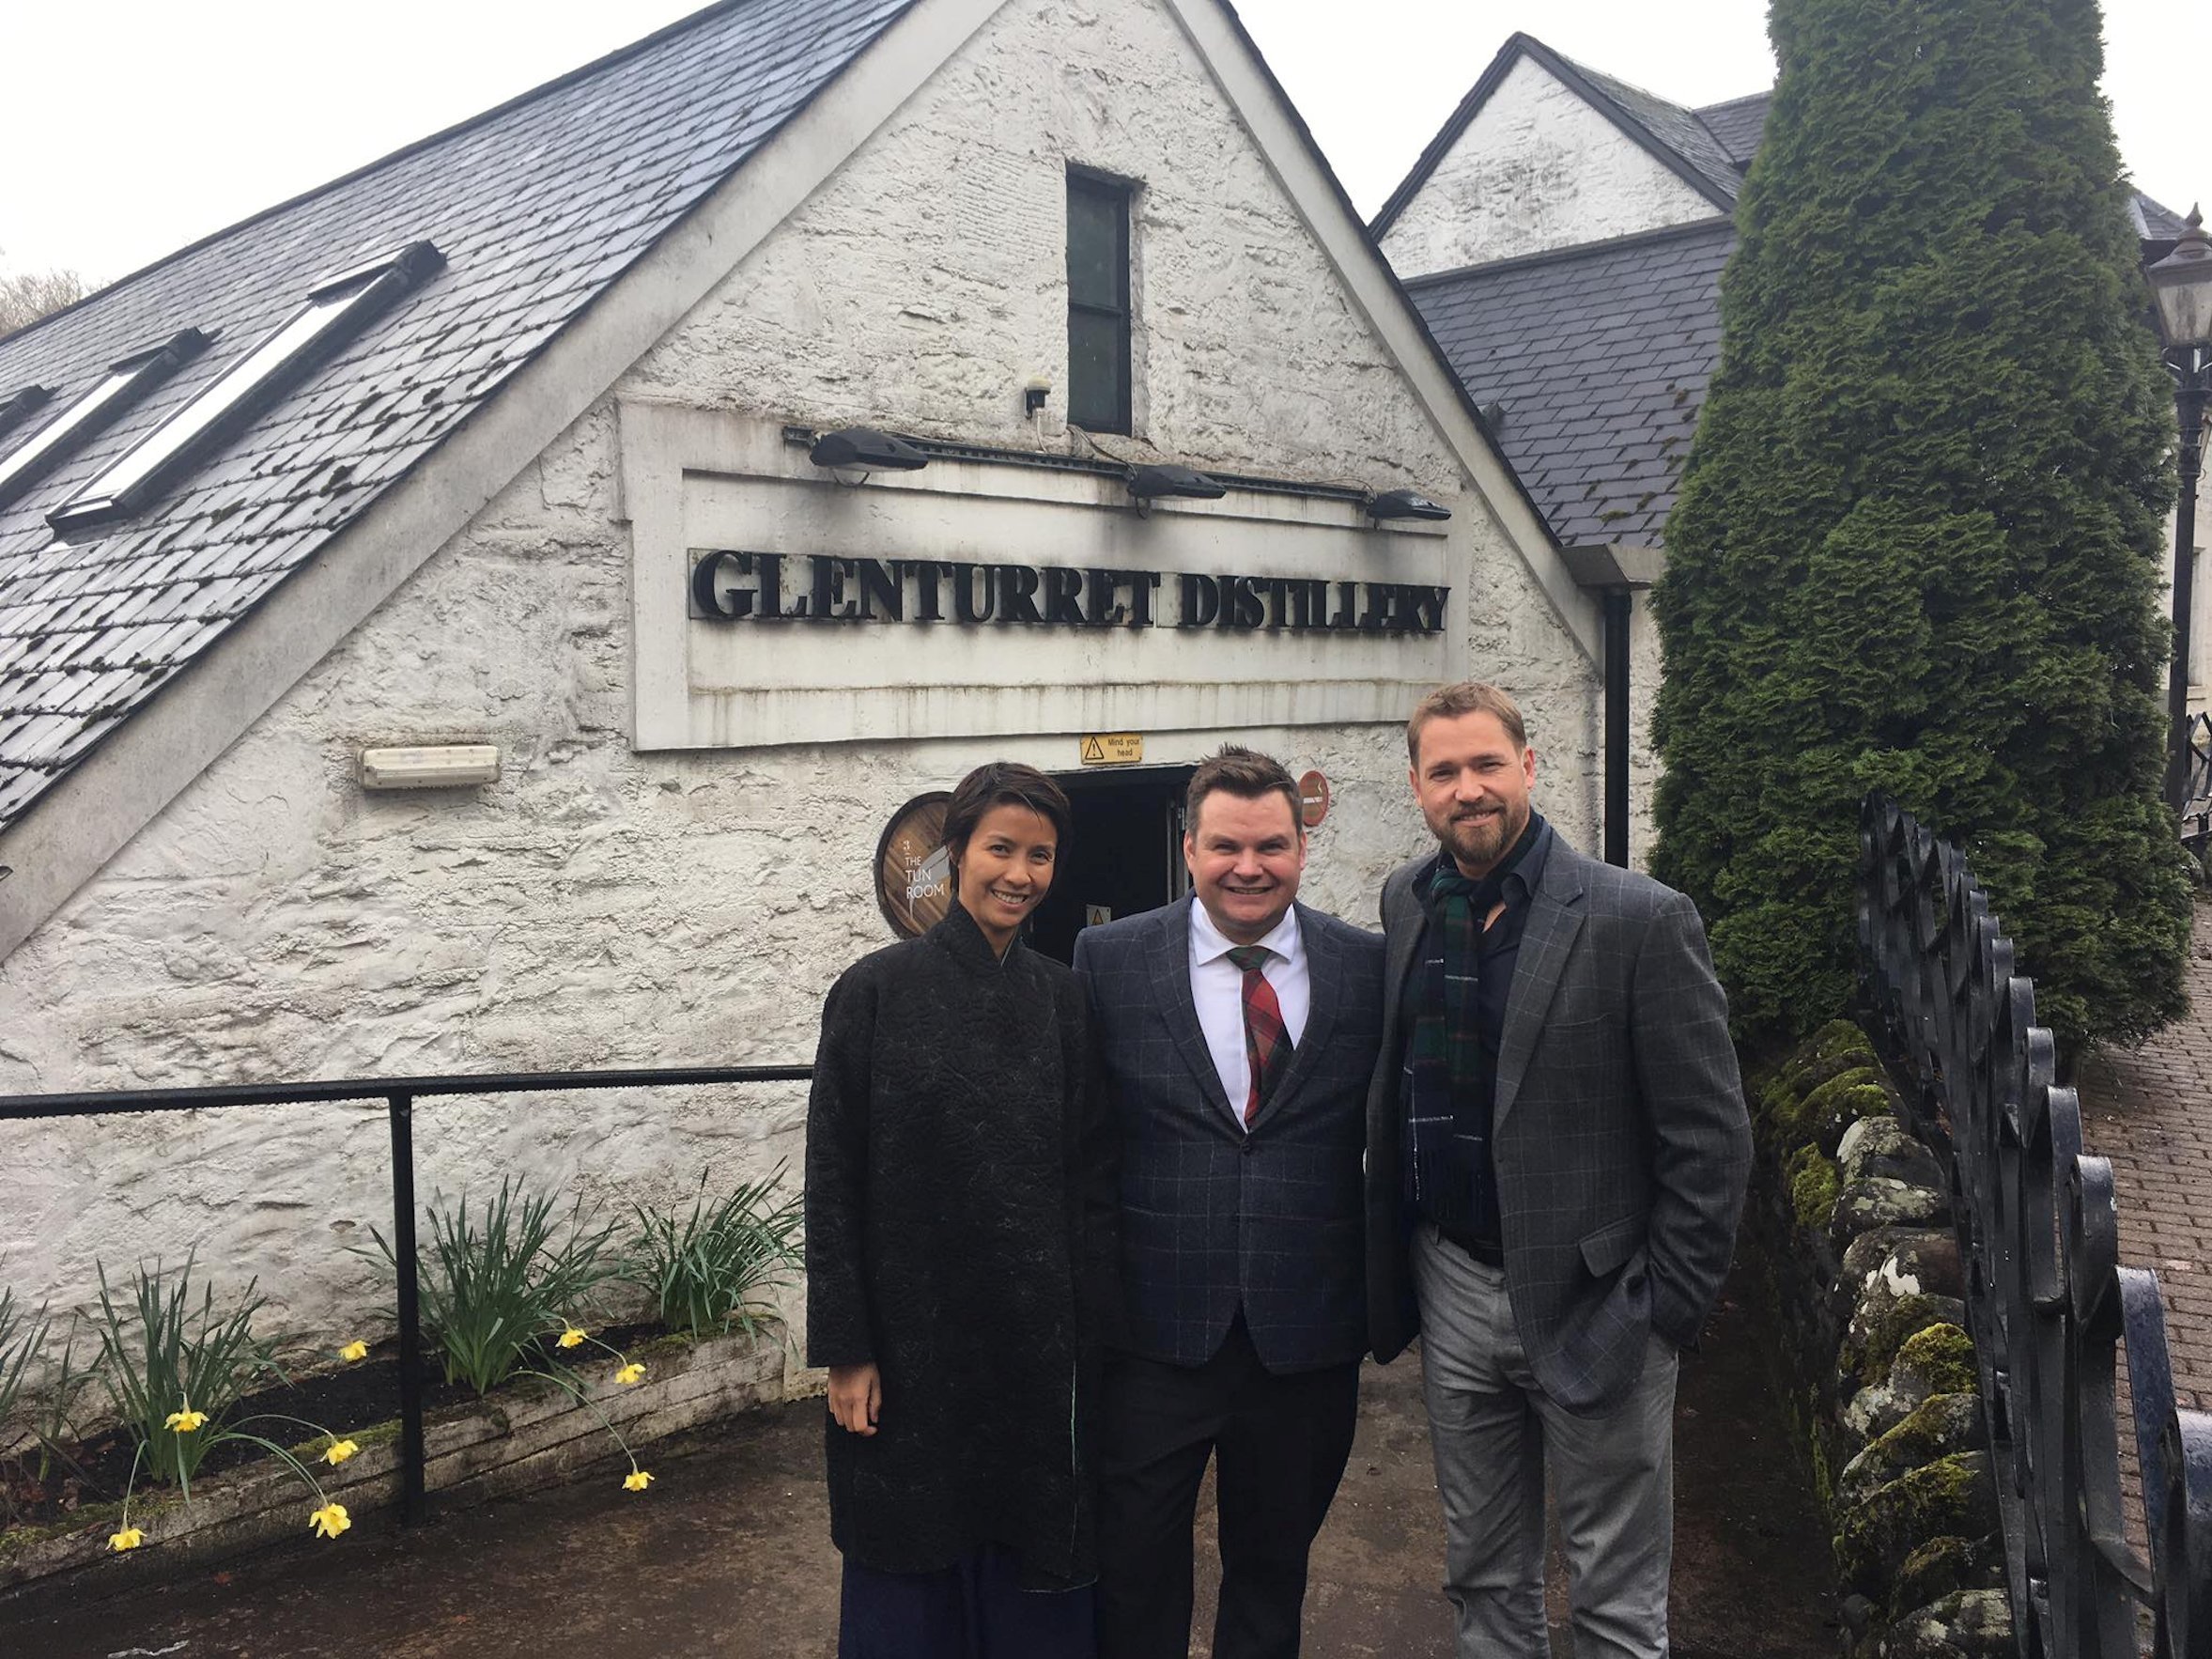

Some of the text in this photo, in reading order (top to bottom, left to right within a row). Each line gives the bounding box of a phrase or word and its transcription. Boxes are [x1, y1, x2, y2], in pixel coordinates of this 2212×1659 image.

[692, 549, 1452, 631] GLENTURRET DISTILLERY
[1108, 737, 1139, 747] Mind your
[1117, 748, 1133, 756] head
[903, 840, 910, 850] 3
[905, 856, 921, 866] THE
[905, 869, 931, 882] TUN
[906, 883, 945, 899] ROOM
